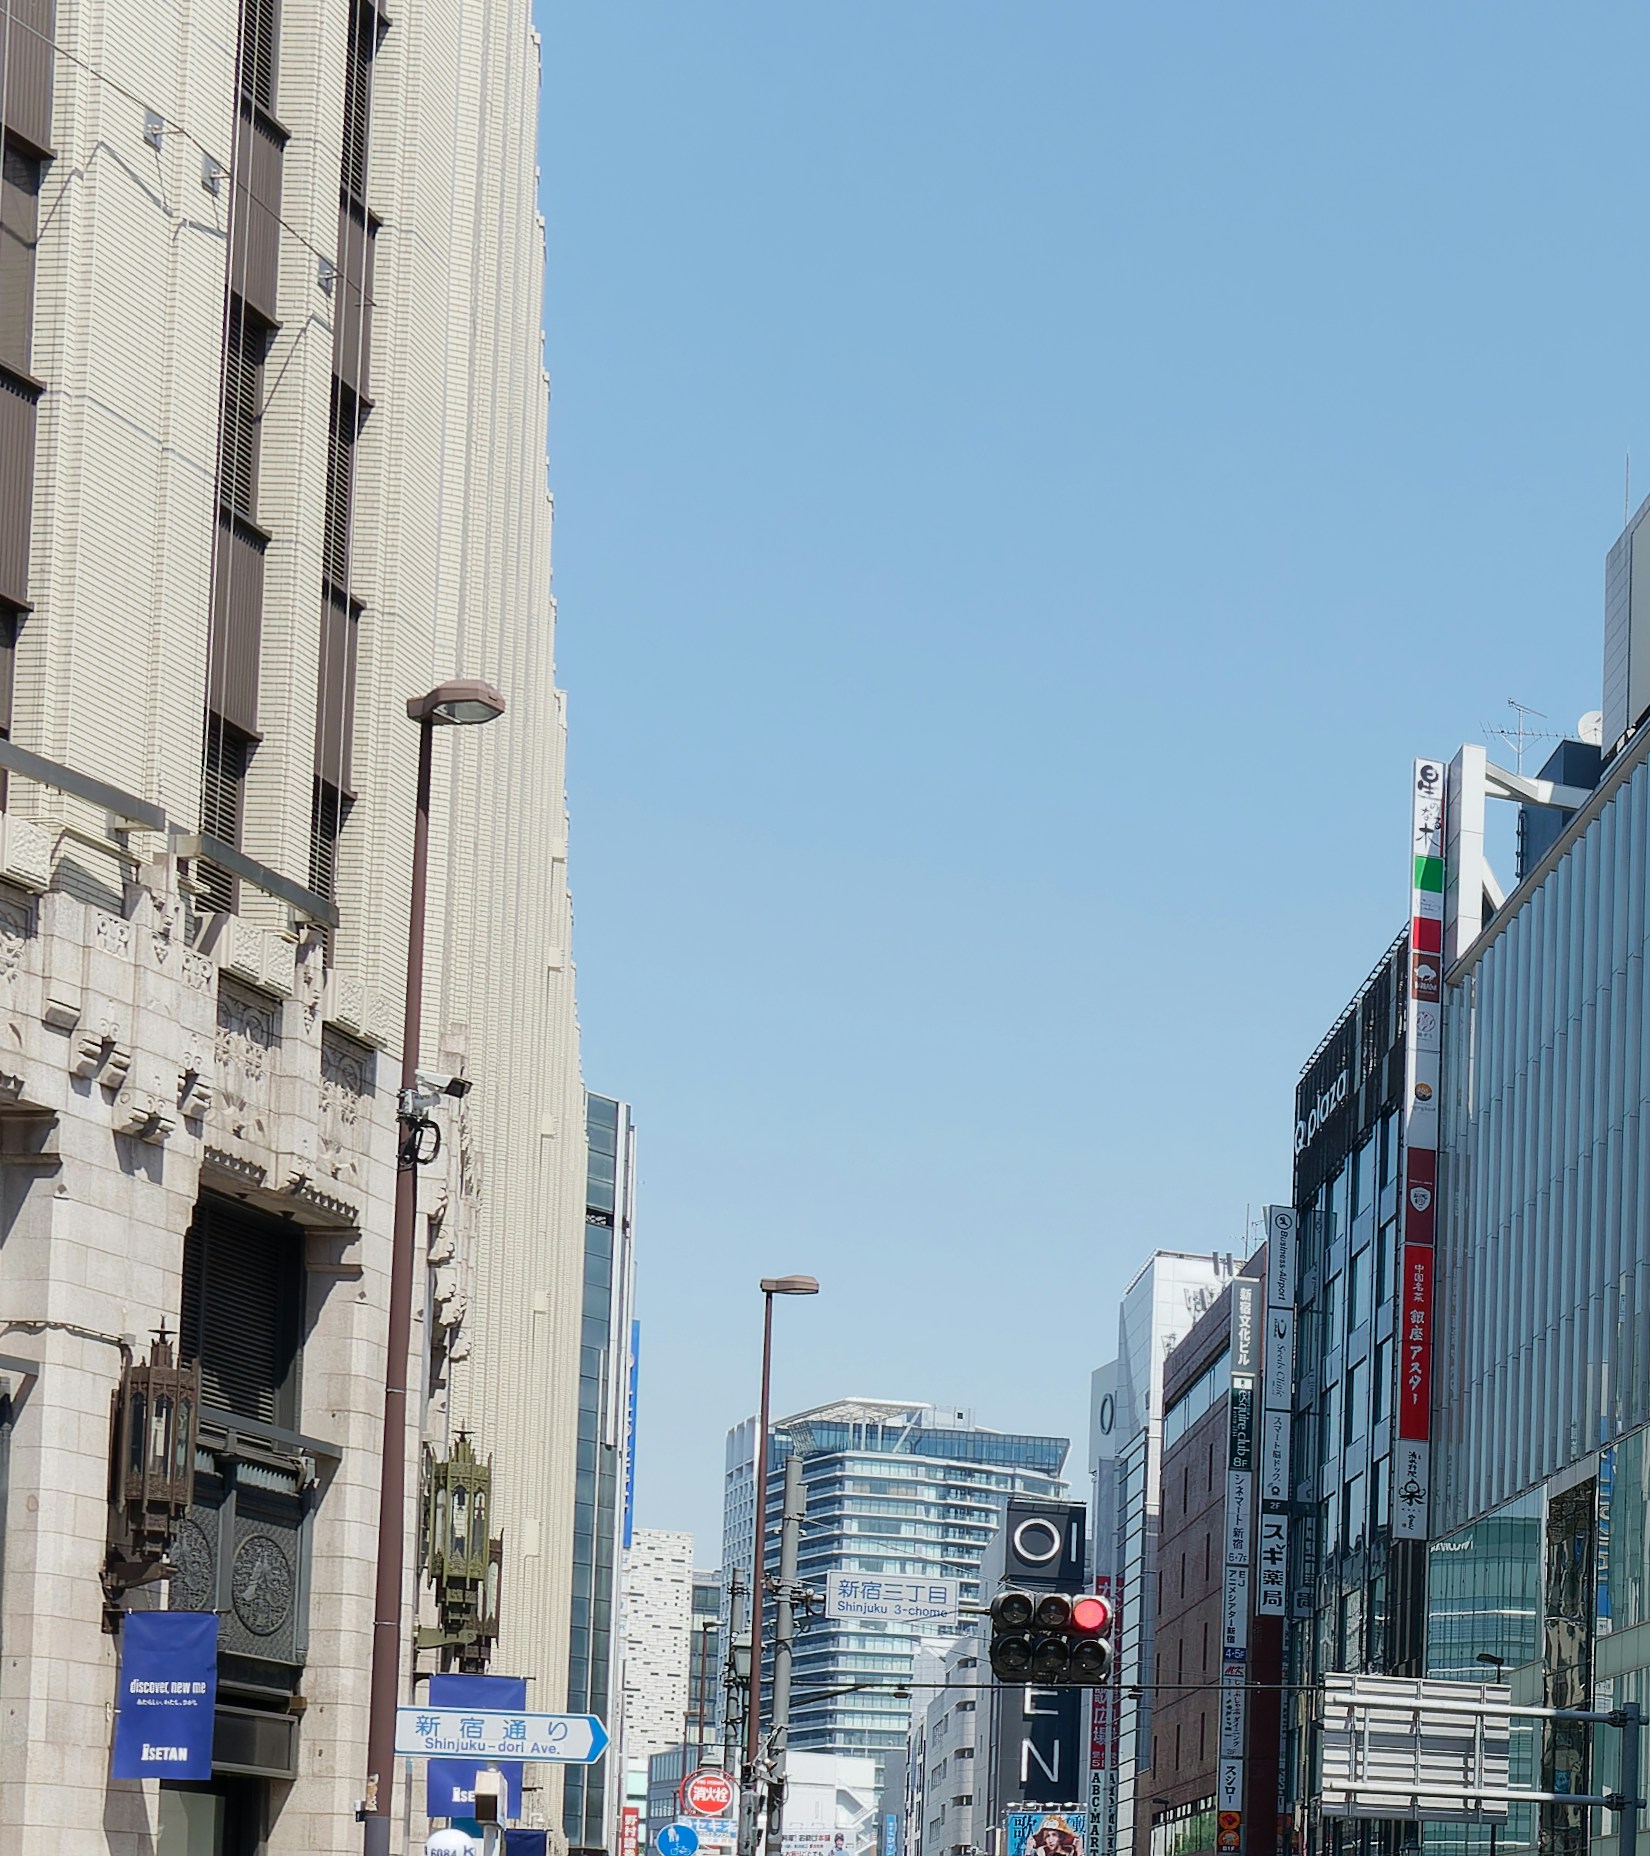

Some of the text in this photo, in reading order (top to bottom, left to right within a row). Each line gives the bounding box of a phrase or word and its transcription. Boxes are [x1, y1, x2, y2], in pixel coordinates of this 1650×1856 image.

[1412, 1264, 1424, 1303] 中国名菜
[1237, 1287, 1253, 1367] 新宿文化ビル
[1409, 1308, 1426, 1405] 銀座アスター
[1233, 1389, 1251, 1456] esquire club
[1233, 1456, 1248, 1468] 8F
[1232, 1474, 1245, 1550] シネマート新宿
[1269, 1502, 1281, 1510] 2F
[1262, 1523, 1287, 1607] スギ薬局
[837, 1578, 948, 1605] 新宿三丁目
[837, 1600, 948, 1619] Shinjuku 3-chome
[1226, 1570, 1238, 1644] アニメシアター新宿
[171, 1681, 191, 1694] new
[192, 1681, 207, 1694] me
[415, 1715, 569, 1742] 新宿通り
[141, 1743, 188, 1761] ISETAN
[530, 1742, 561, 1755] Ave.
[693, 1786, 728, 1803] 消火栓
[1224, 1765, 1237, 1804] スシロー
